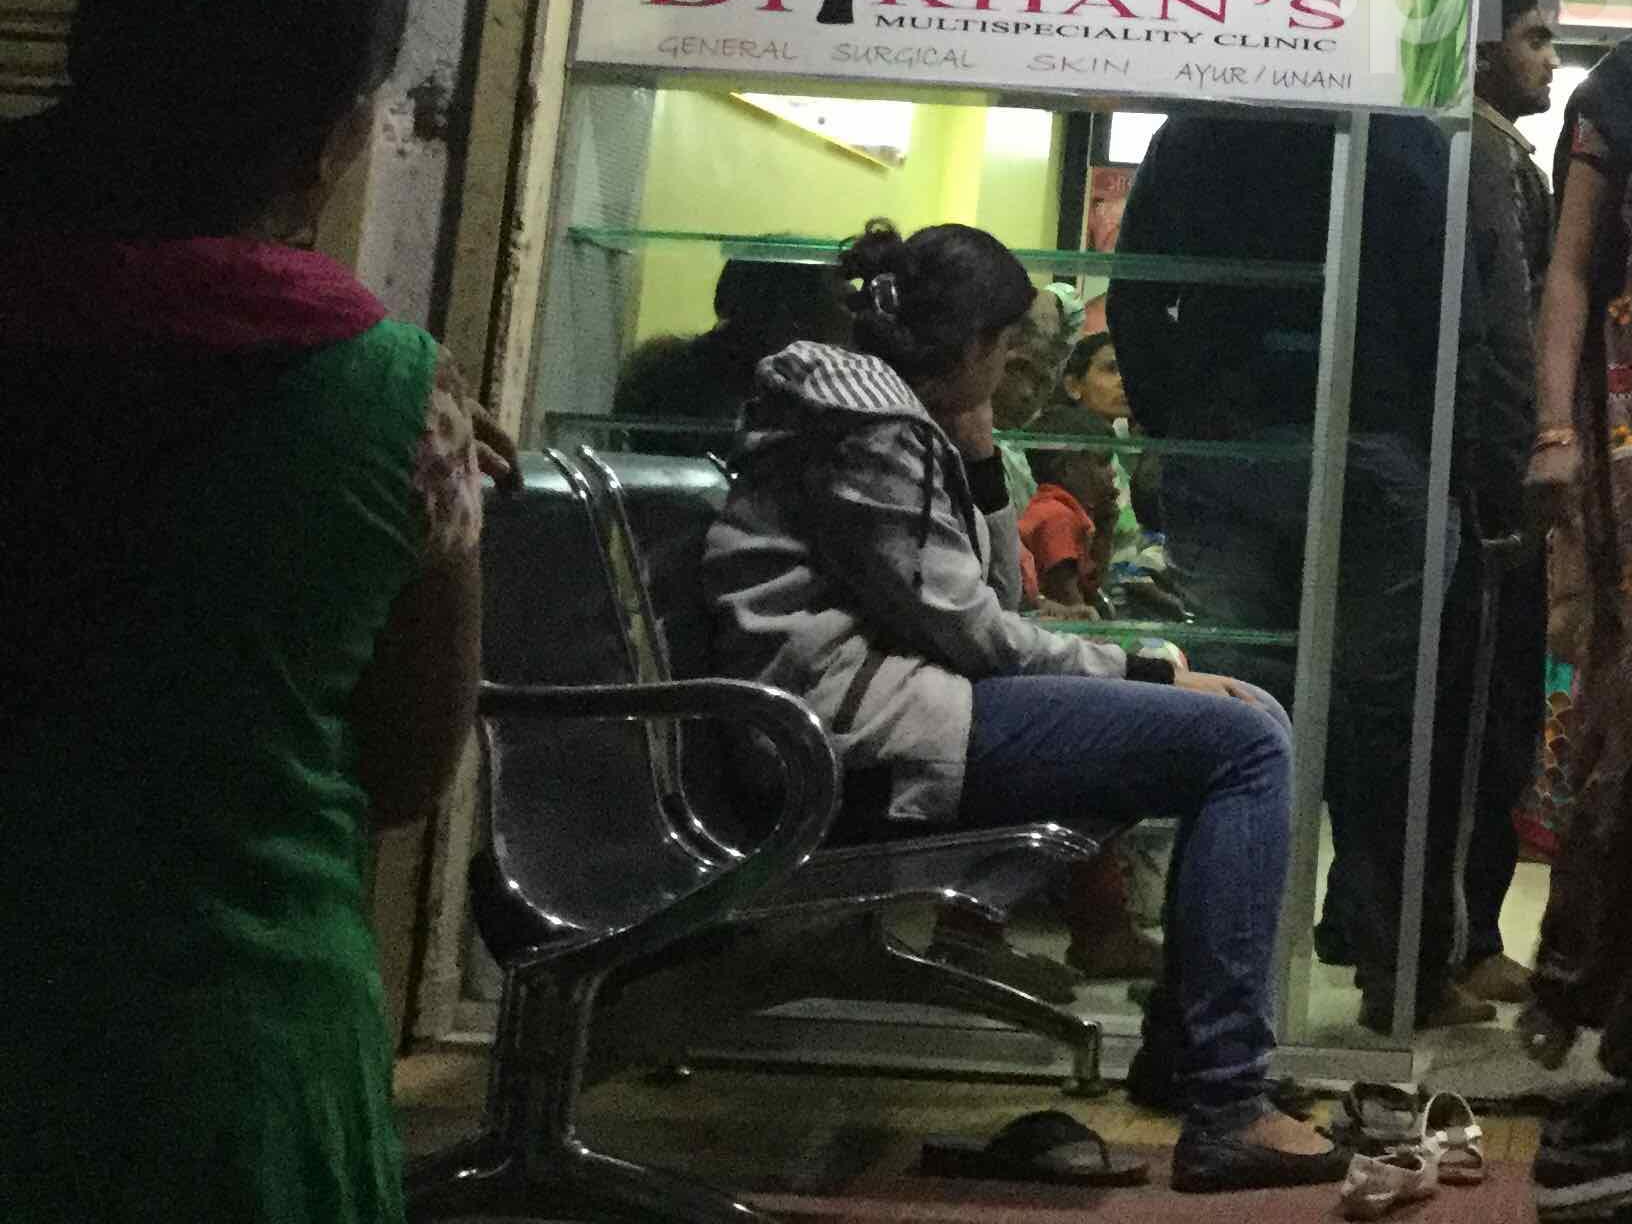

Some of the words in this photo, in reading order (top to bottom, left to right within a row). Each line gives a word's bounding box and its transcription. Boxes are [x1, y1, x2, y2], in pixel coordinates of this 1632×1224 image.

[874, 14, 1203, 46] MULTISPECIALITY
[1213, 33, 1337, 53] CLINIC
[658, 35, 798, 61] GENERAL
[831, 42, 978, 69] SURGICAL
[1026, 54, 1131, 76] SKIN
